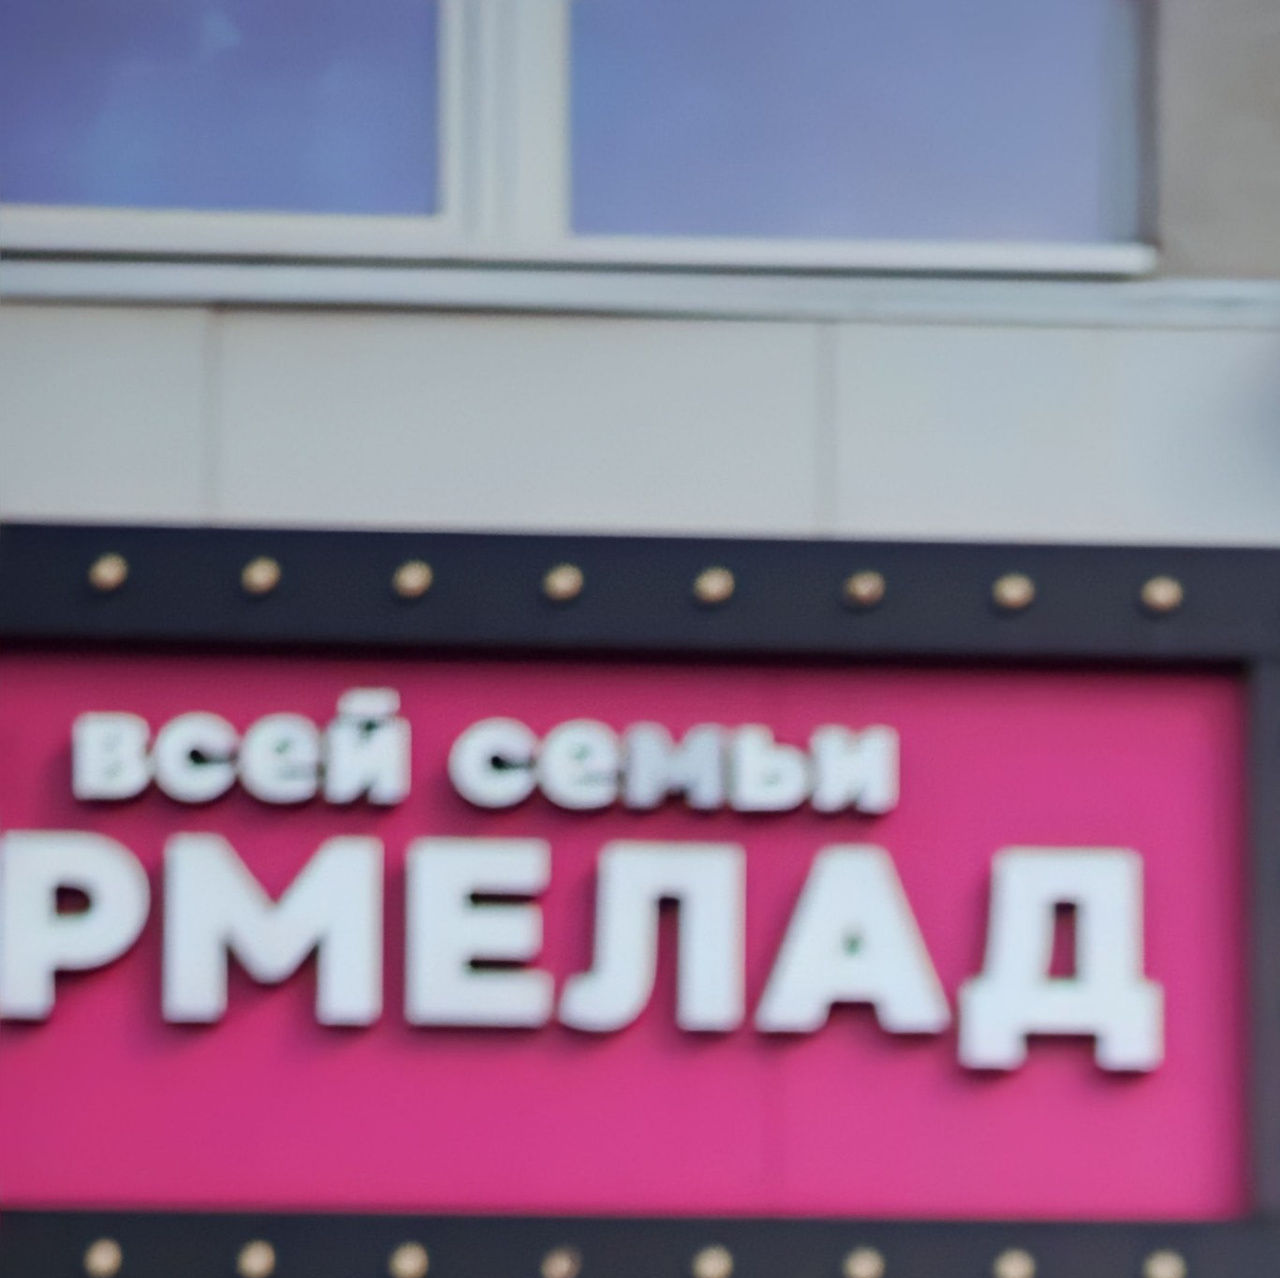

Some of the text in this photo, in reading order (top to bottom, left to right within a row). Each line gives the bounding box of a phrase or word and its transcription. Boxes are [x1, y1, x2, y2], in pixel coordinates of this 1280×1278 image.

[71, 687, 900, 815] всей семьи
[0, 829, 1166, 1072] РМЕЛАД
